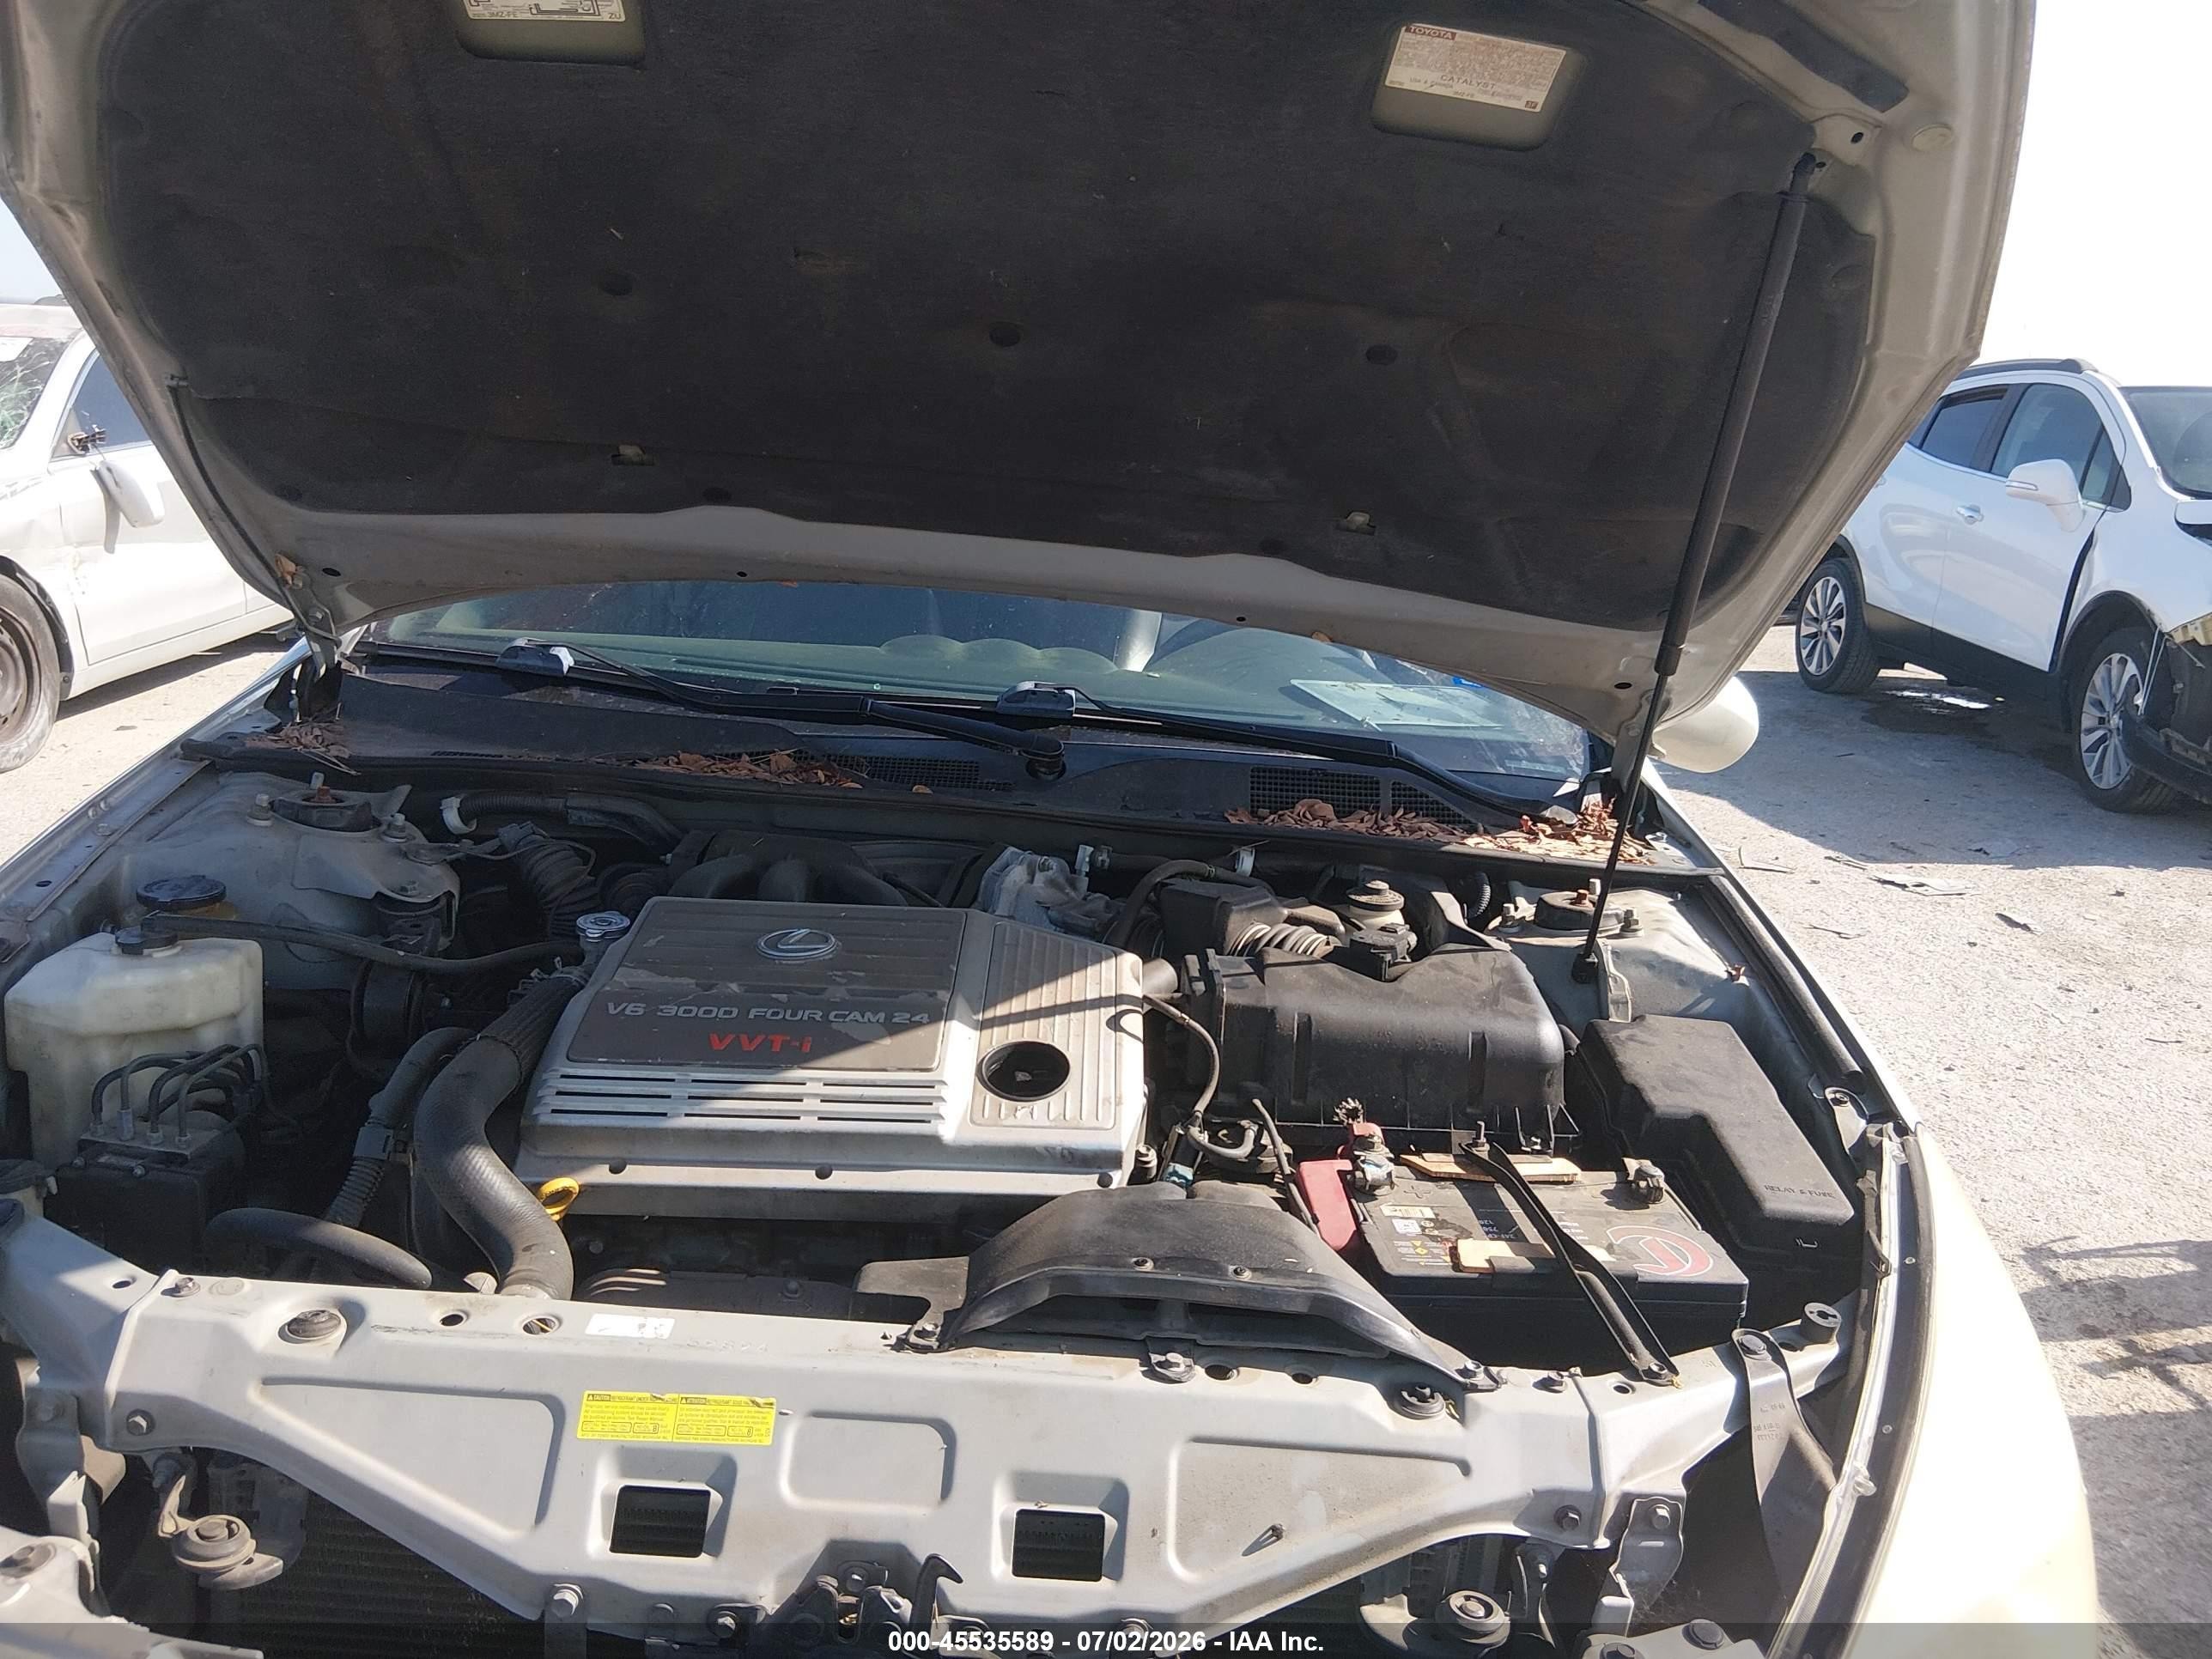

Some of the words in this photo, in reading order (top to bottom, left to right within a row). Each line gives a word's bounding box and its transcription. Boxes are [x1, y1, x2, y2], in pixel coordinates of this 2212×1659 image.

[1408, 26, 1454, 40] TOYOTA
[1440, 74, 1496, 90] CATALYST
[607, 1002, 647, 1016] V6
[748, 1007, 823, 1022] FOUR
[828, 1010, 886, 1024] CAM
[891, 1012, 930, 1024] 24
[709, 1033, 812, 1053] VVT-i
[1764, 1184, 1796, 1194] RELAY
[1808, 1189, 1836, 1199] FUSE
